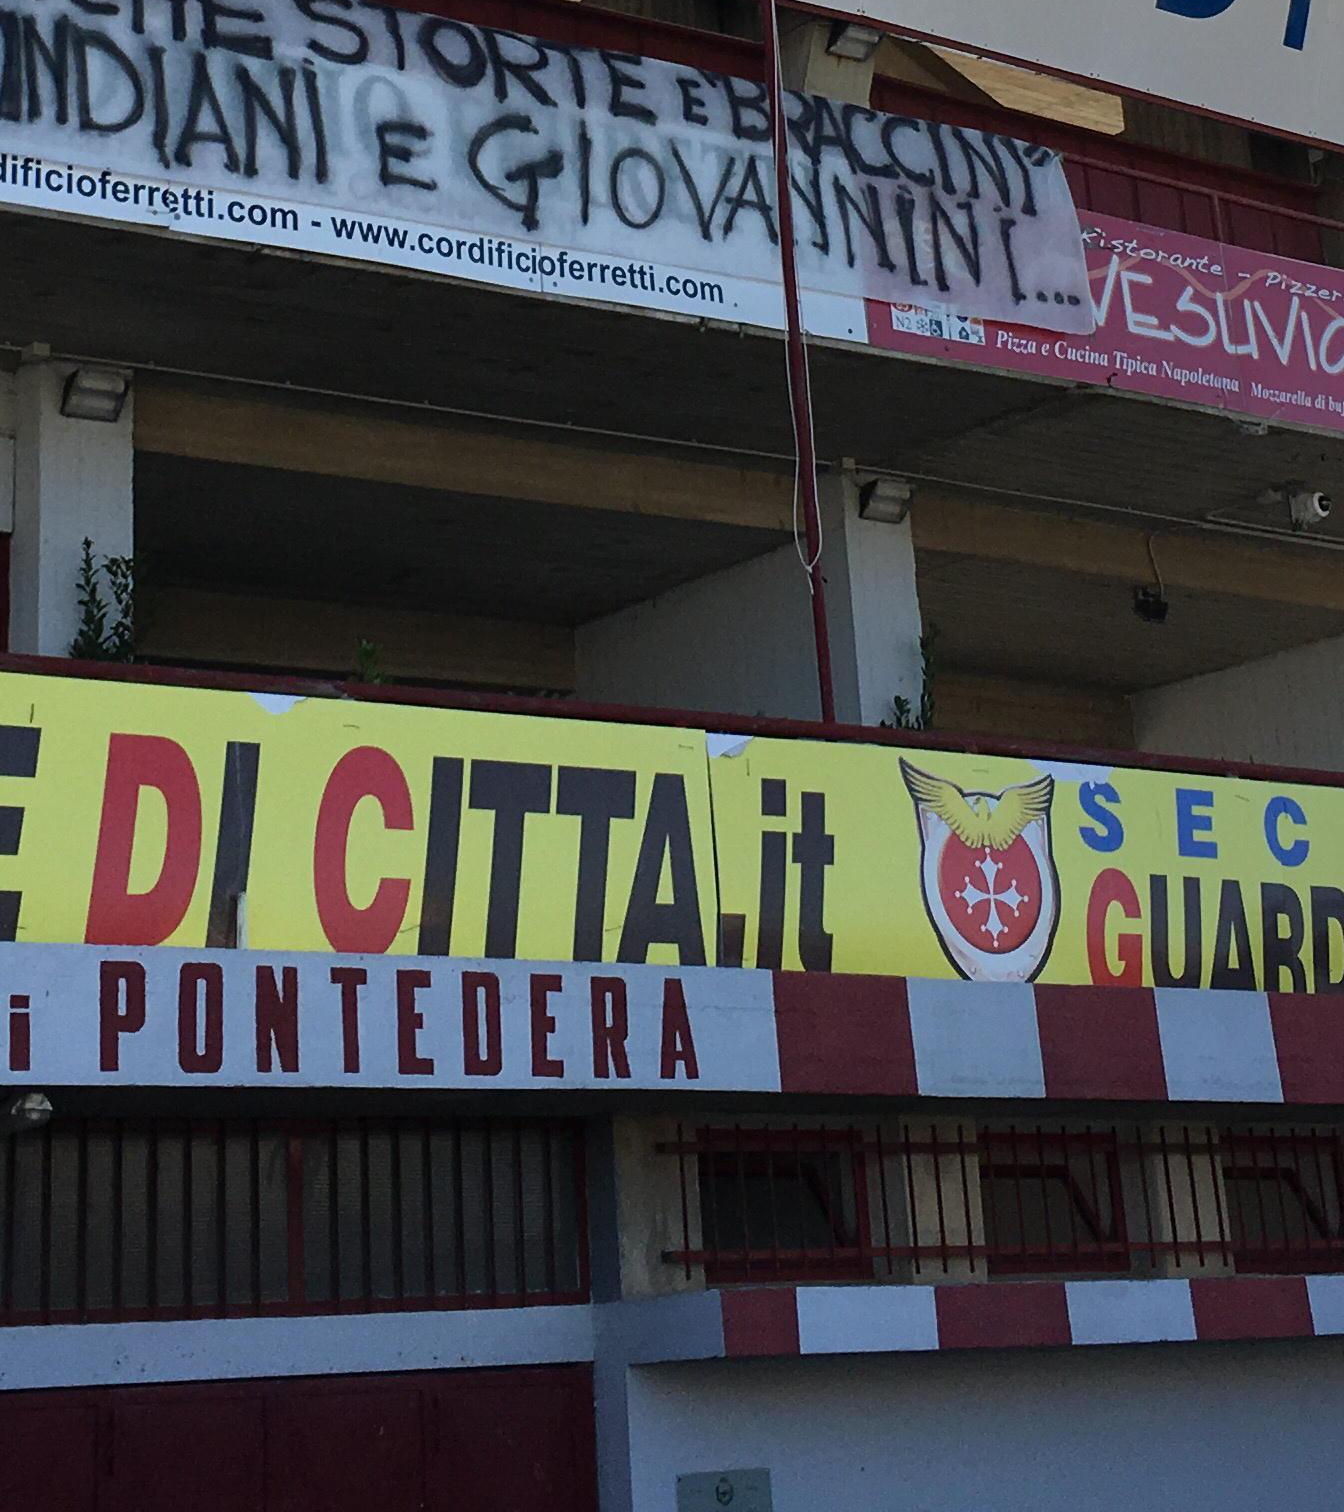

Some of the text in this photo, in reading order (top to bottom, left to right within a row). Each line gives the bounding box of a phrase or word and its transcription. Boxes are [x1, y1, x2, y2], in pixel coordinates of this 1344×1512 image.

[675, 76, 711, 126] E
[376, 118, 437, 190] E
[331, 216, 725, 304] www.cordificioferretti.com
[996, 330, 1036, 355] Pizza
[1041, 343, 1049, 356] e
[1054, 341, 1109, 369] Cucina
[1113, 349, 1158, 378] Tipica
[1161, 359, 1240, 394] Napoletana
[1250, 381, 1312, 409] Mozzarella
[1315, 393, 1326, 410] di
[83, 732, 262, 950] DI
[99, 958, 702, 1082] PONTEDERA
